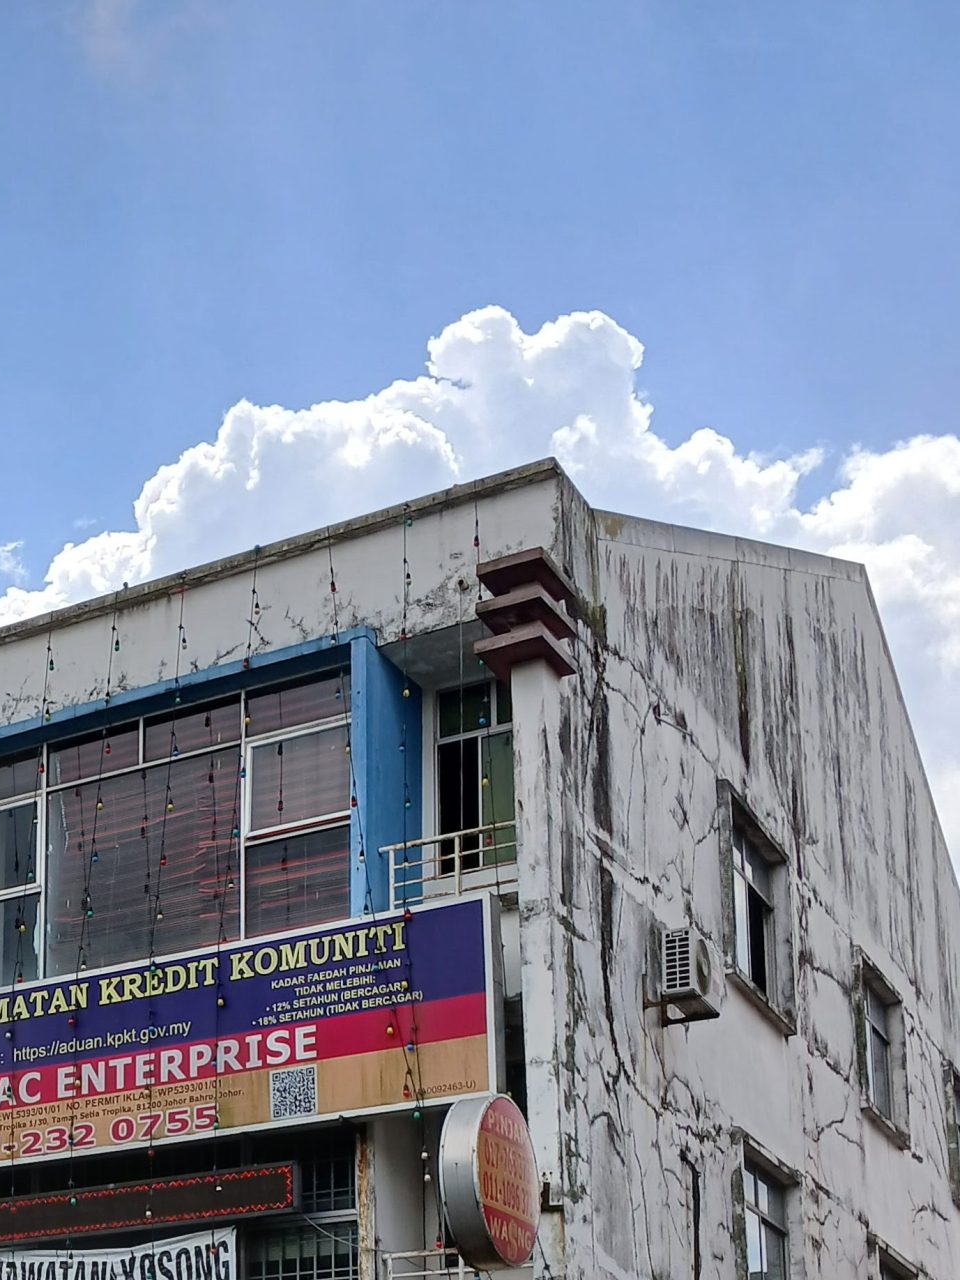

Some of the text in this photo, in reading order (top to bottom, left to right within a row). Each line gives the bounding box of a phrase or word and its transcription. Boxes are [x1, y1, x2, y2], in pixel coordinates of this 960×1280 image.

[99, 957, 219, 1006] KREDIT
[230, 921, 406, 981] KOMUNITI
[271, 976, 305, 989] KADAR
[307, 968, 346, 982] FAEDAH
[294, 975, 376, 996] TIDAK MELEBIHI:
[279, 1008, 324, 1023] SETAHUN
[326, 1002, 359, 1017] (TIDAK
[362, 991, 423, 1009] BERCAGAR)
[293, 994, 338, 1009] SETAHUN
[13, 1021, 192, 1062] https://aduan.kpkt.gov.my
[57, 1025, 318, 1098] ENTERPRISE
[52, 1114, 78, 1124] Taman
[80, 1109, 100, 1119] Setia
[164, 1097, 187, 1107] Johor
[85, 1095, 120, 1108] PERMIT
[110, 1103, 220, 1143] 0755
